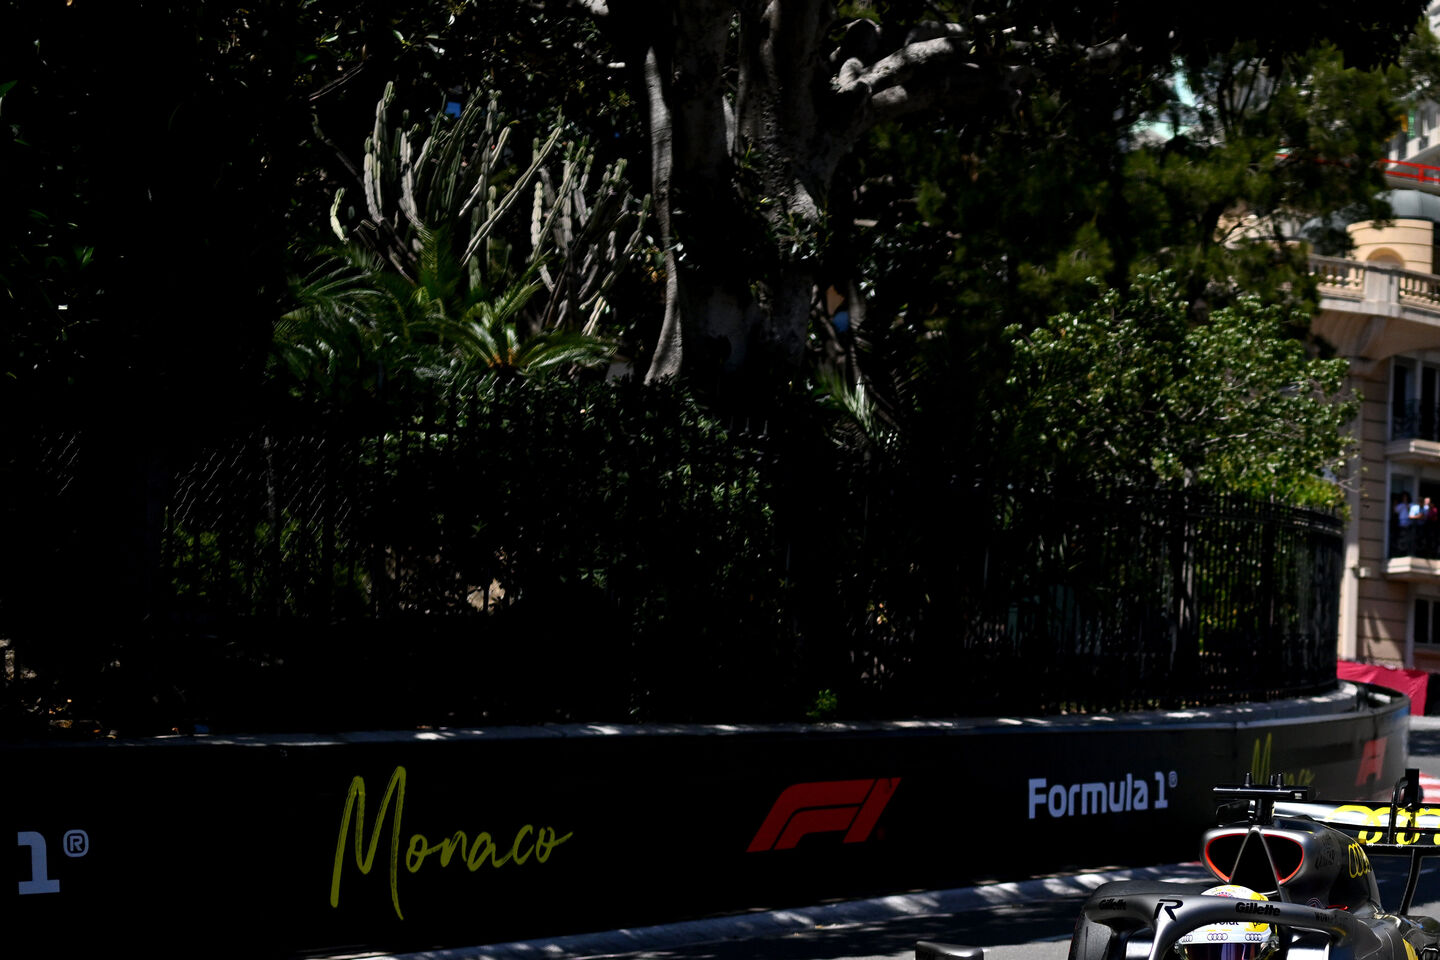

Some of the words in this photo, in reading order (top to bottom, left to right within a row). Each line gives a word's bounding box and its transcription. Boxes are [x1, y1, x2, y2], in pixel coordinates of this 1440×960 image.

[1028, 773, 1149, 819] Formula
[330, 766, 573, 921] Monaco
[1235, 902, 1280, 916] Gillette
